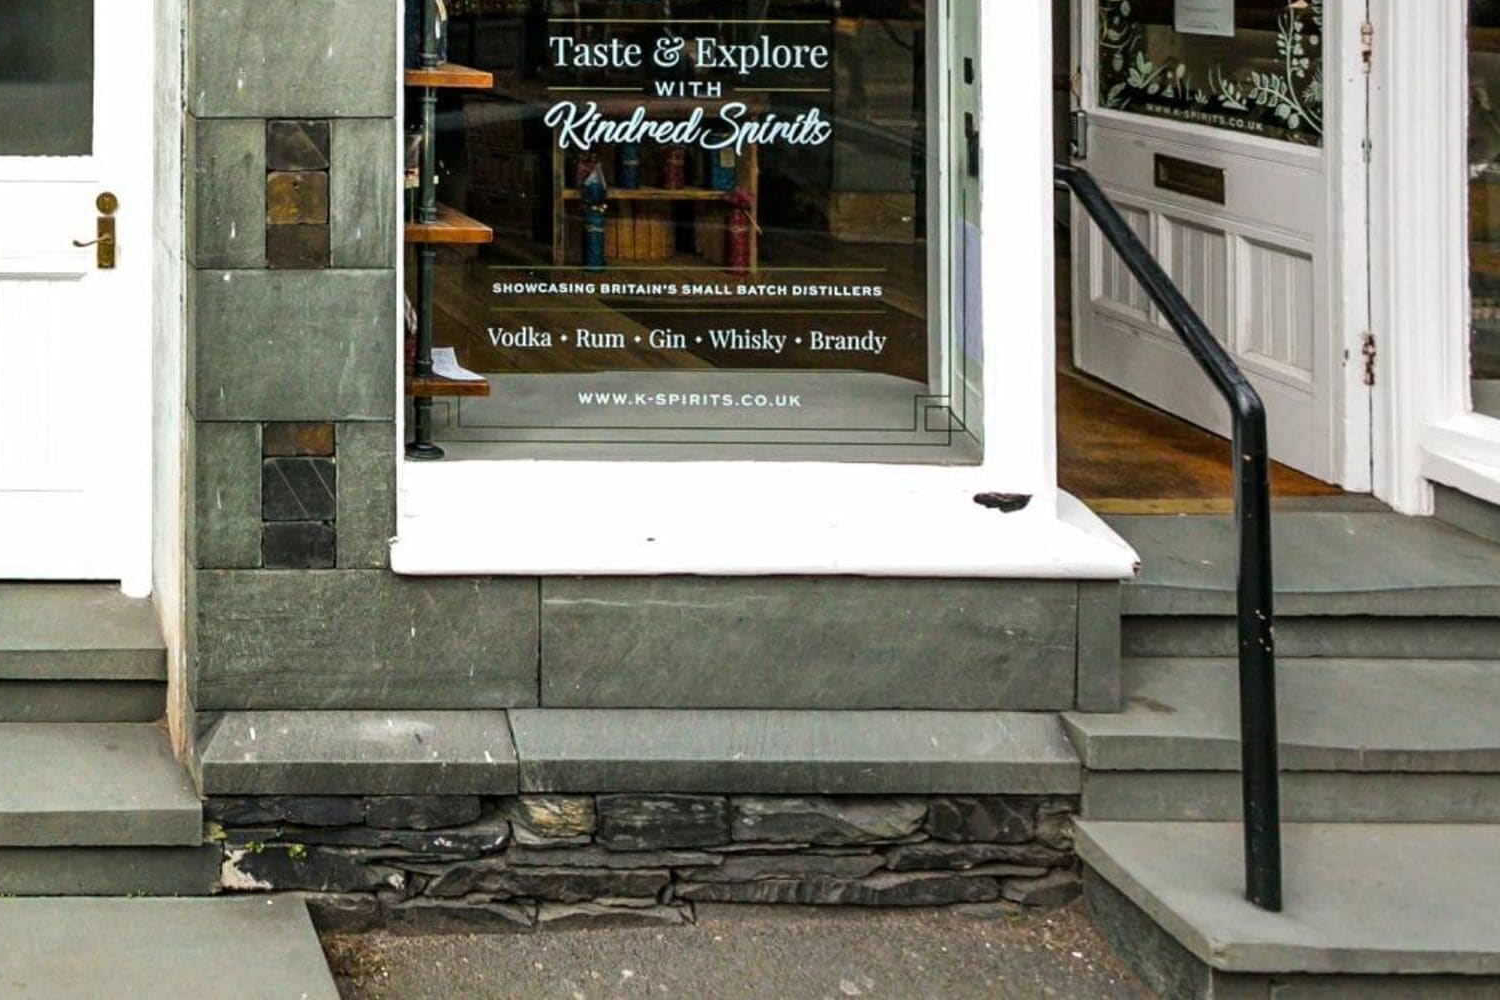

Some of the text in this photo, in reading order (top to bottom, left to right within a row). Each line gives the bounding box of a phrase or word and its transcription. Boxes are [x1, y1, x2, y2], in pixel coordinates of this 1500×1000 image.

[549, 35, 828, 75] Taste & Explore
[655, 81, 722, 98] WITH
[544, 101, 832, 156] Kindred Spirits
[492, 282, 882, 297] SHOWCASING BRITAIN'S SMALL BATCH DISTILLERS
[487, 326, 887, 354] Vodka Rum Gin Whisky Brandy
[578, 391, 801, 407] WWW.K-SPIRITS.CO.UK
